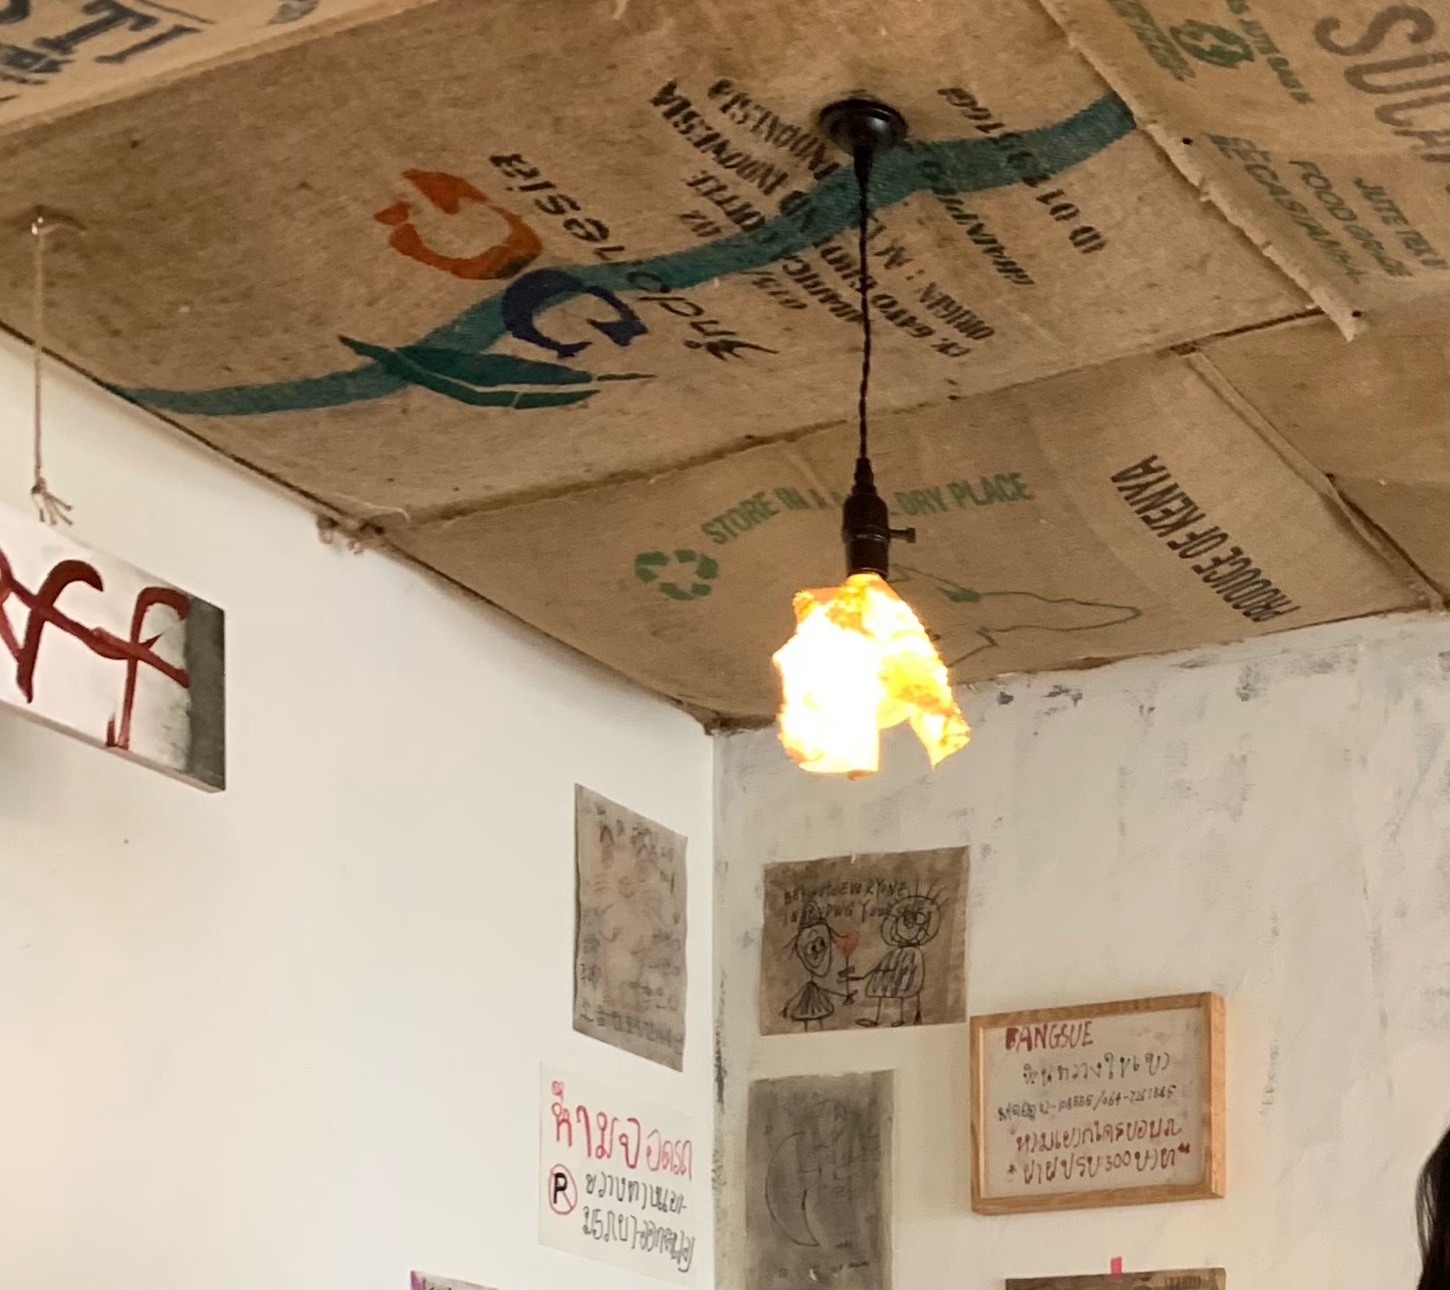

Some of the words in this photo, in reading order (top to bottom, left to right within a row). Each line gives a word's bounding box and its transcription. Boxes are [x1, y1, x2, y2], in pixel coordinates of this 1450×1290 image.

[703, 487, 781, 546] STORE
[952, 472, 1031, 507] PLACE
[1110, 453, 1208, 537] KENYA
[1167, 524, 1230, 561] OF
[1191, 546, 1300, 623] PRODUCE
